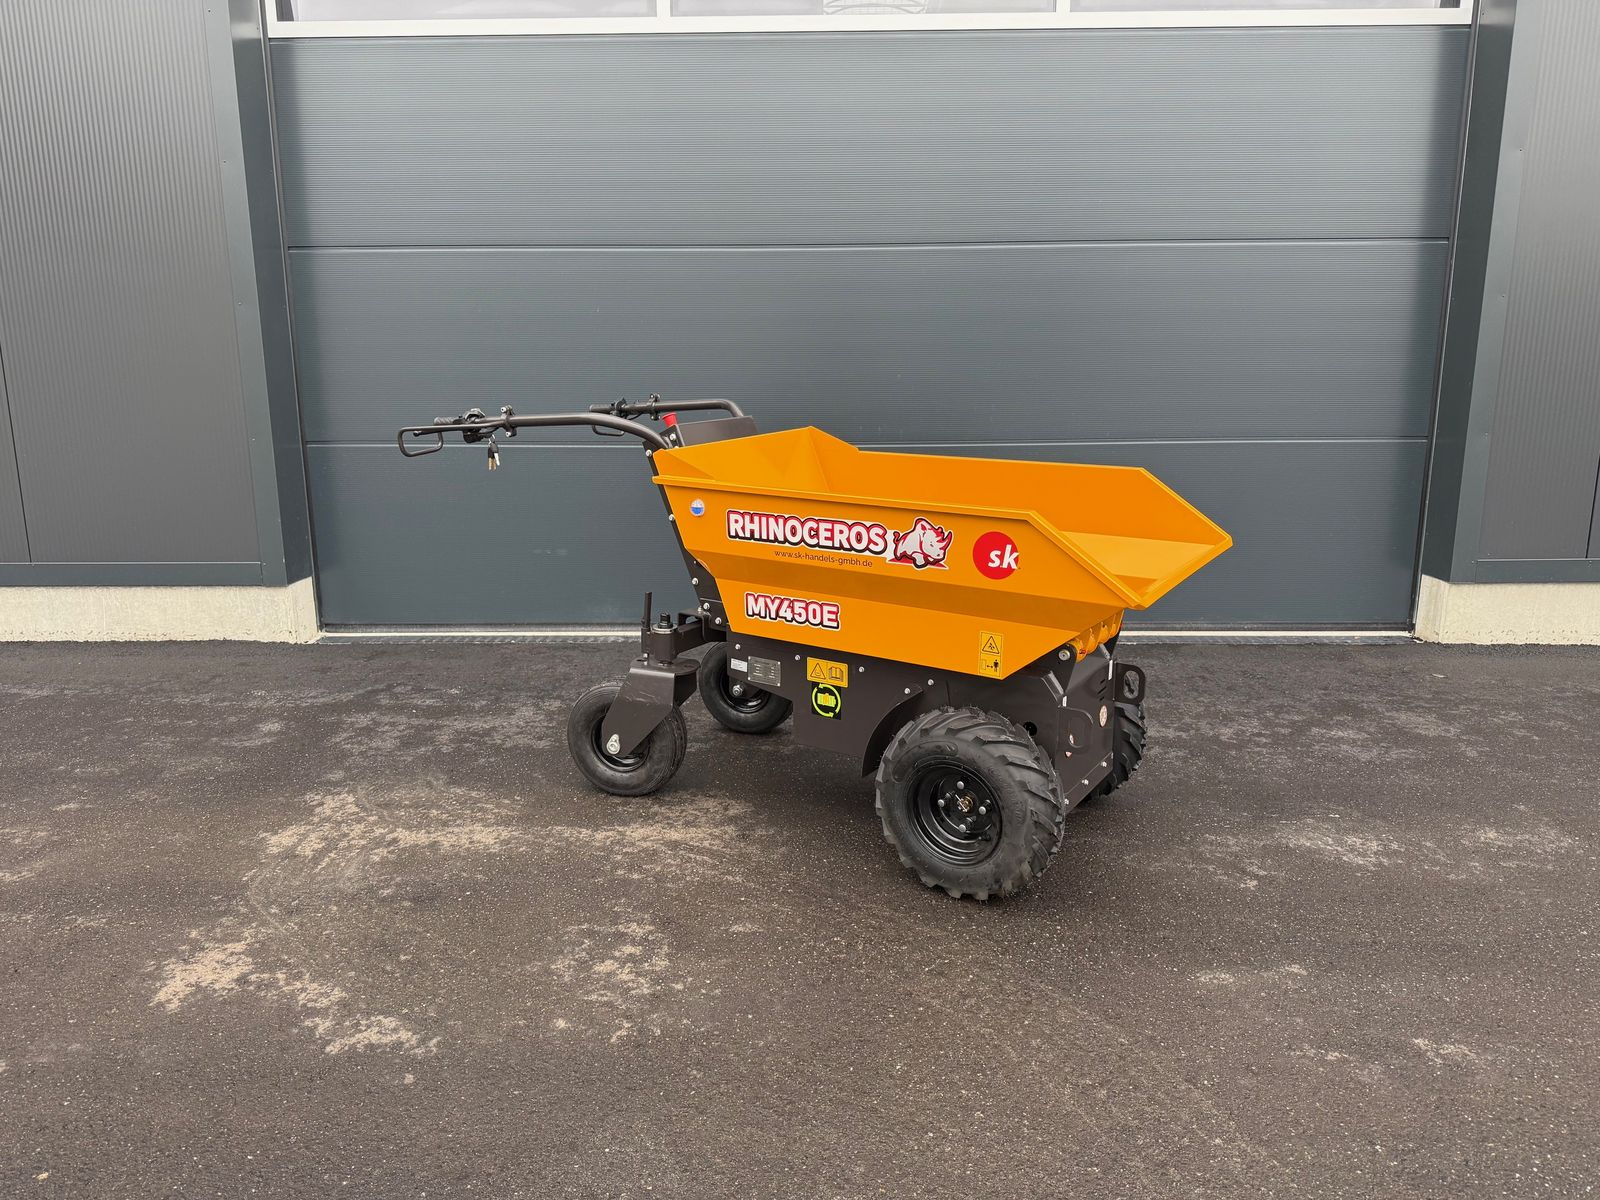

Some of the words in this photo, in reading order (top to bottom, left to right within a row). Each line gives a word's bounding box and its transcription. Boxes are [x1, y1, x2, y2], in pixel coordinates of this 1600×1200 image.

[728, 512, 887, 552] RHINOCEROS
[774, 550, 873, 567] www.sk-handels-gmbh.de
[988, 546, 1019, 570] sk
[746, 594, 840, 628] MY450E
